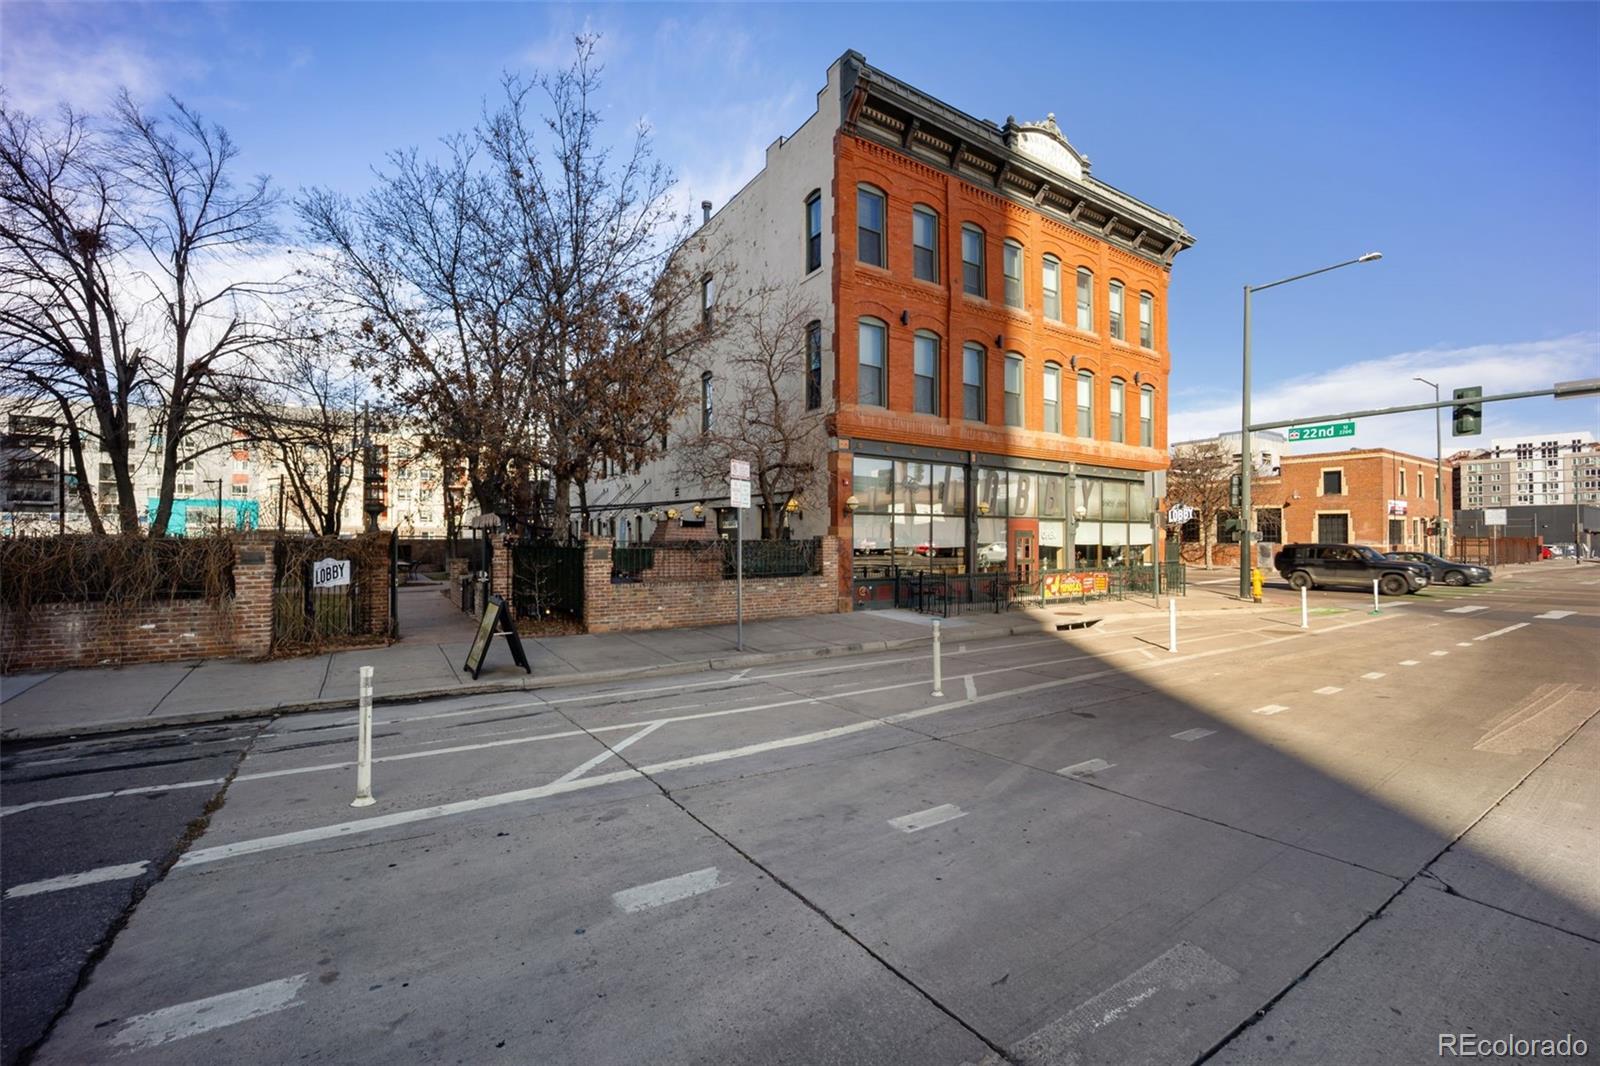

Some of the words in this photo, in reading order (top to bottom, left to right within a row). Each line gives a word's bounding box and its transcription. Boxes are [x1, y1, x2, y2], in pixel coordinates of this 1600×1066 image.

[1303, 426, 1334, 439] 22nd
[1168, 508, 1194, 522] LOBBY
[316, 563, 345, 585] LOBBY
